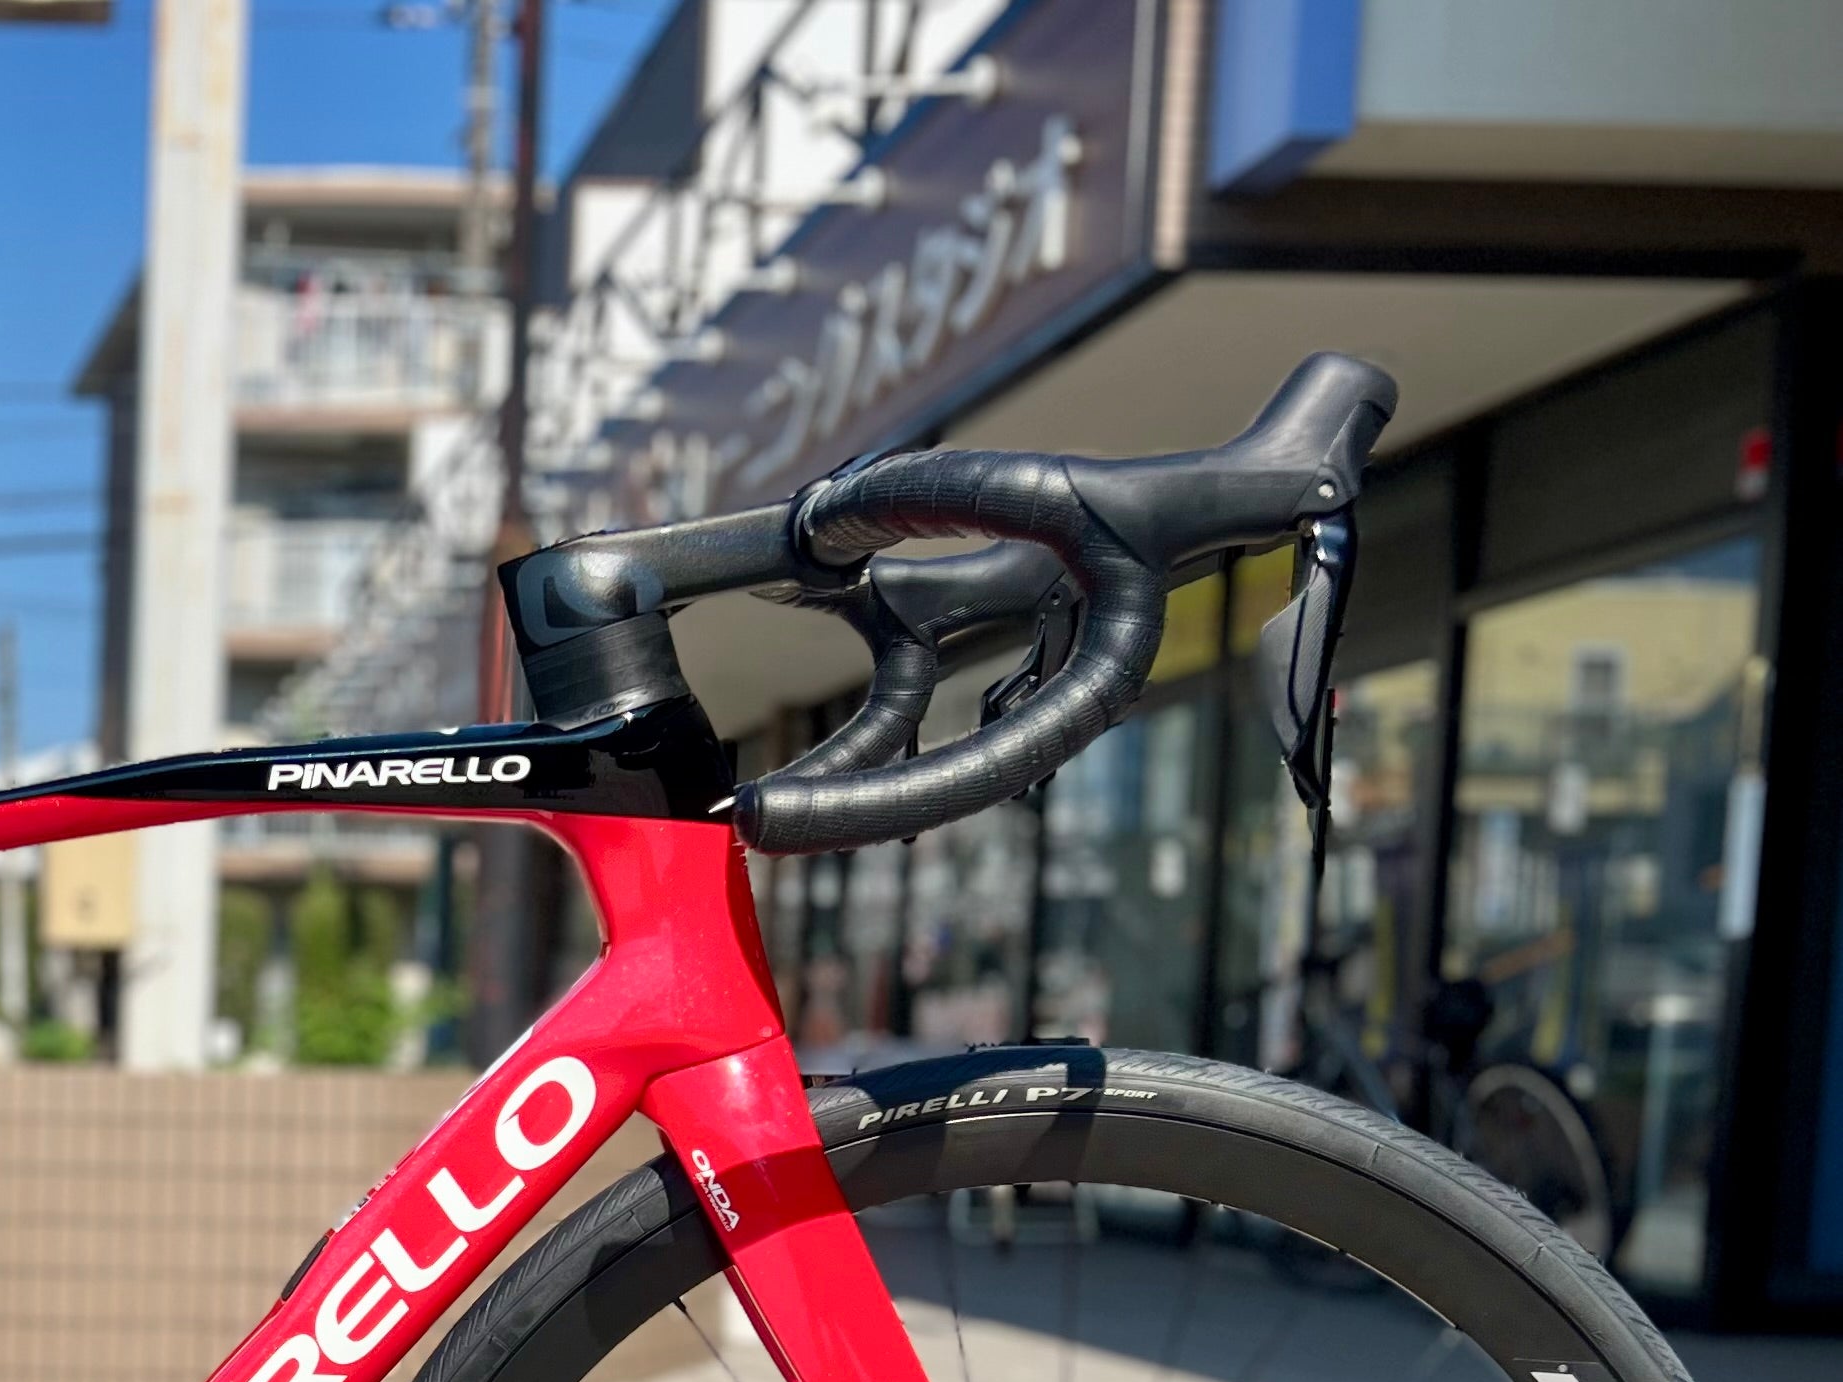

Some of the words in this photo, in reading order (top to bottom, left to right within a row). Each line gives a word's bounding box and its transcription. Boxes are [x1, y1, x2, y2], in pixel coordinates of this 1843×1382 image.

[267, 754, 532, 791] PINARELLO
[857, 1089, 1007, 1131] PIRELLI
[1025, 1087, 1094, 1102] P7
[1103, 1087, 1158, 1100] SPORT
[691, 1149, 740, 1230] ONDA
